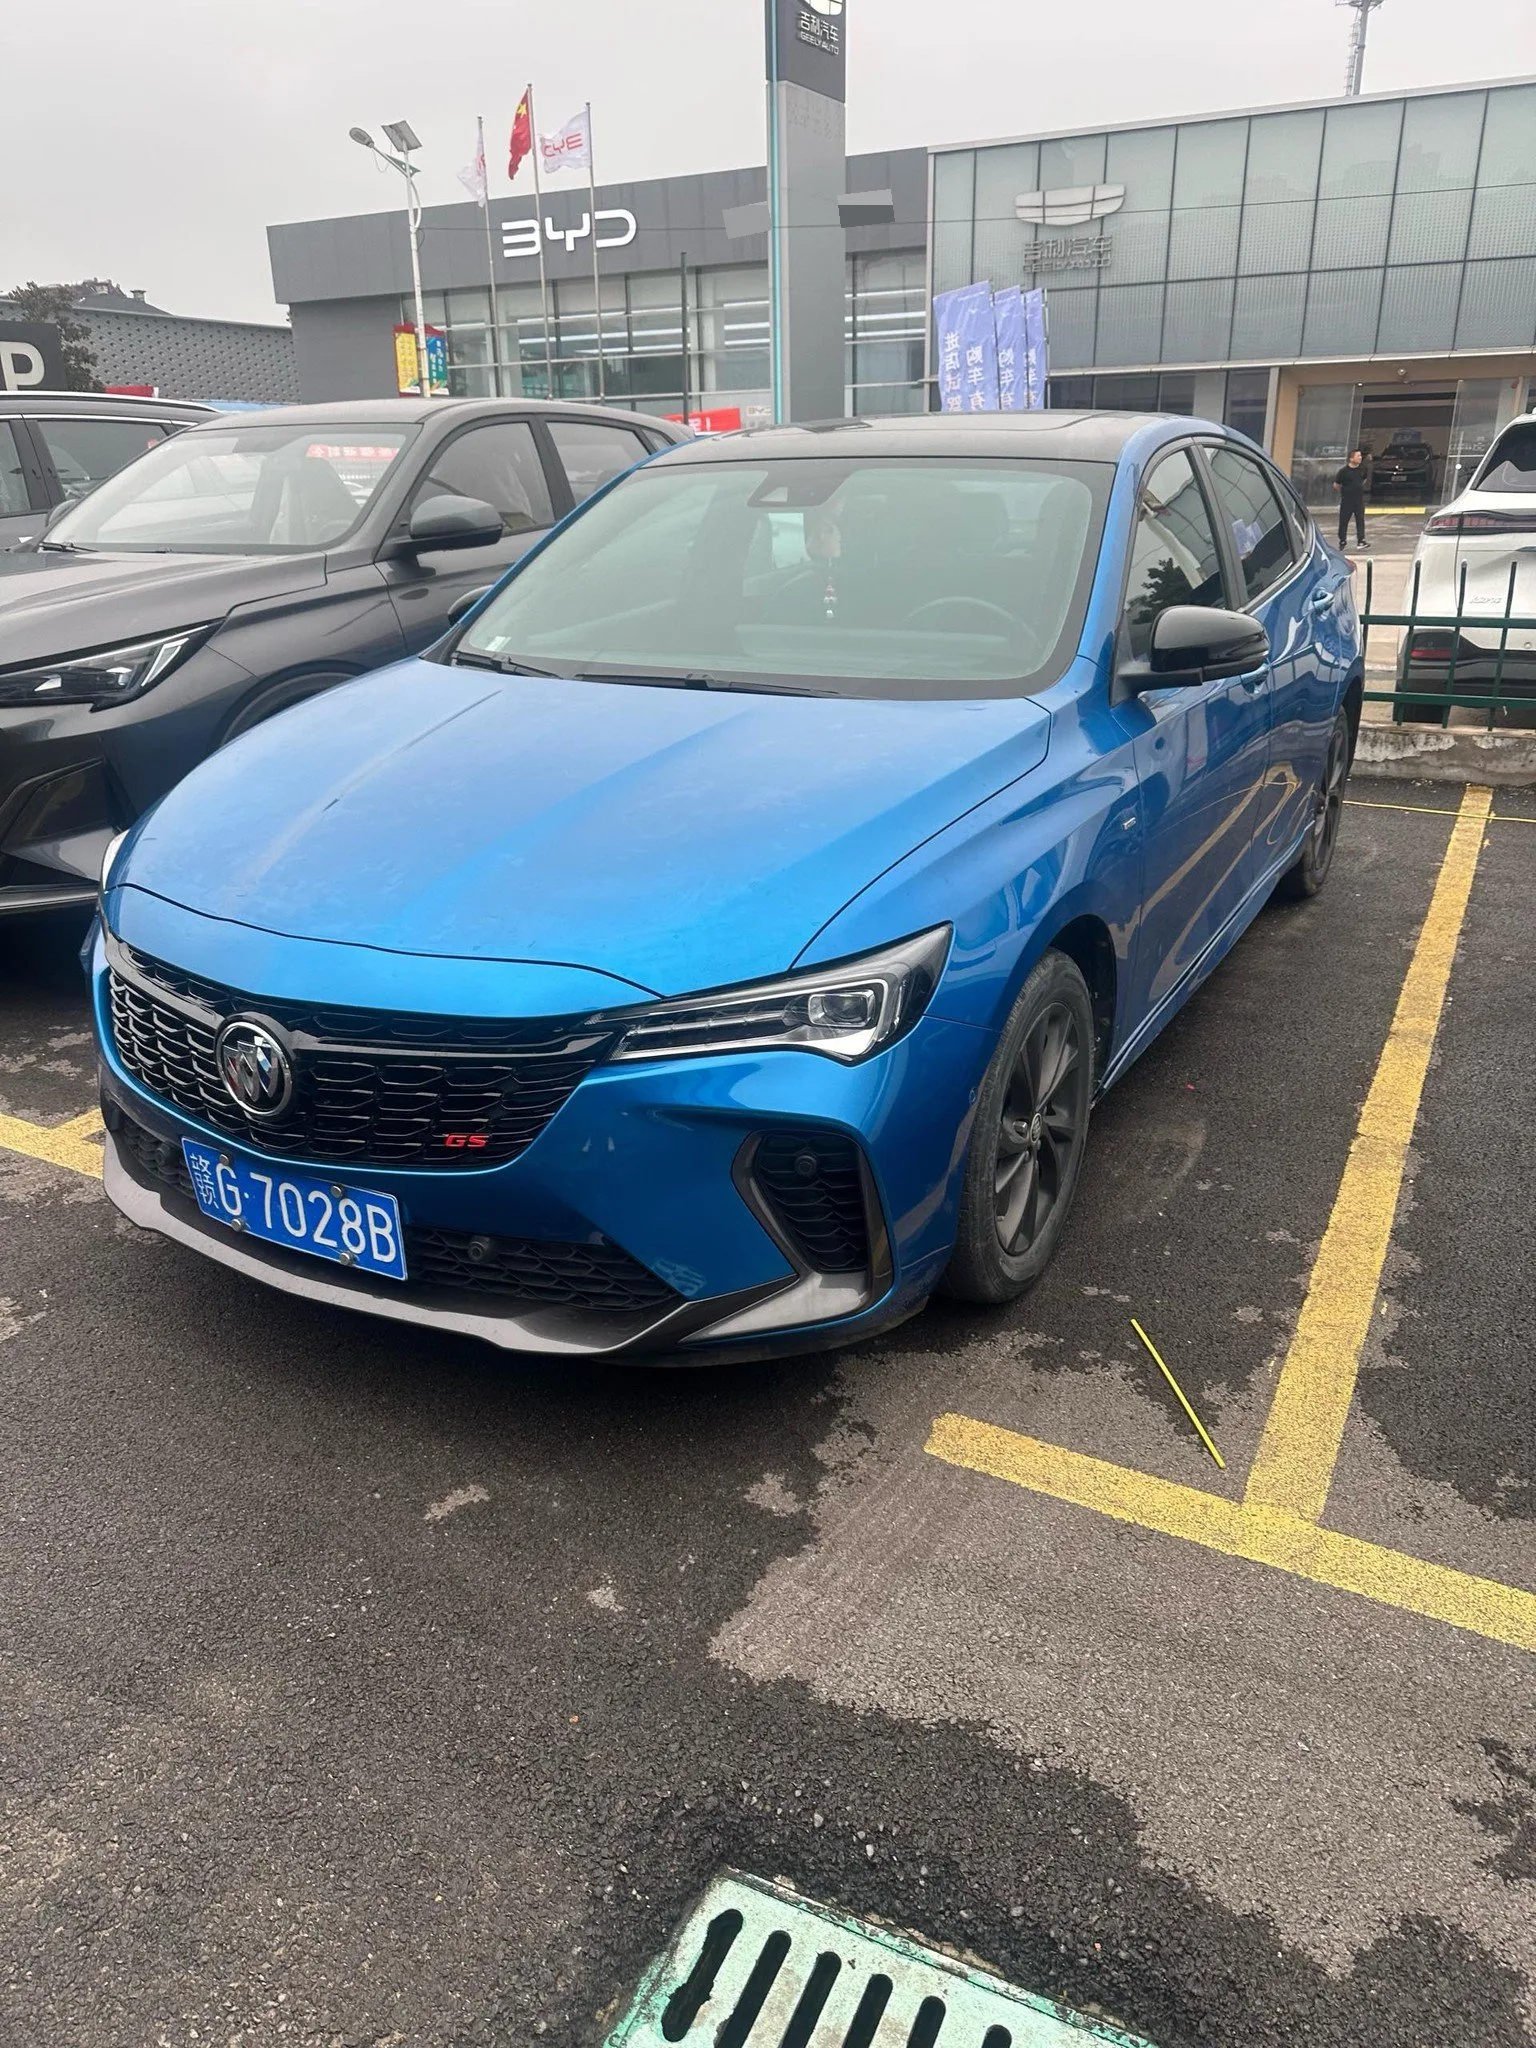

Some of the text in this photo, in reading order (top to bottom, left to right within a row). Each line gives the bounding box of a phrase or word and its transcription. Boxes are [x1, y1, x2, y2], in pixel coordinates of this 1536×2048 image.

[800, 11, 839, 41] 吉利汽车
[502, 209, 637, 257] BYD
[1024, 235, 1112, 260] 吉利汽车
[445, 1135, 489, 1147] GS
